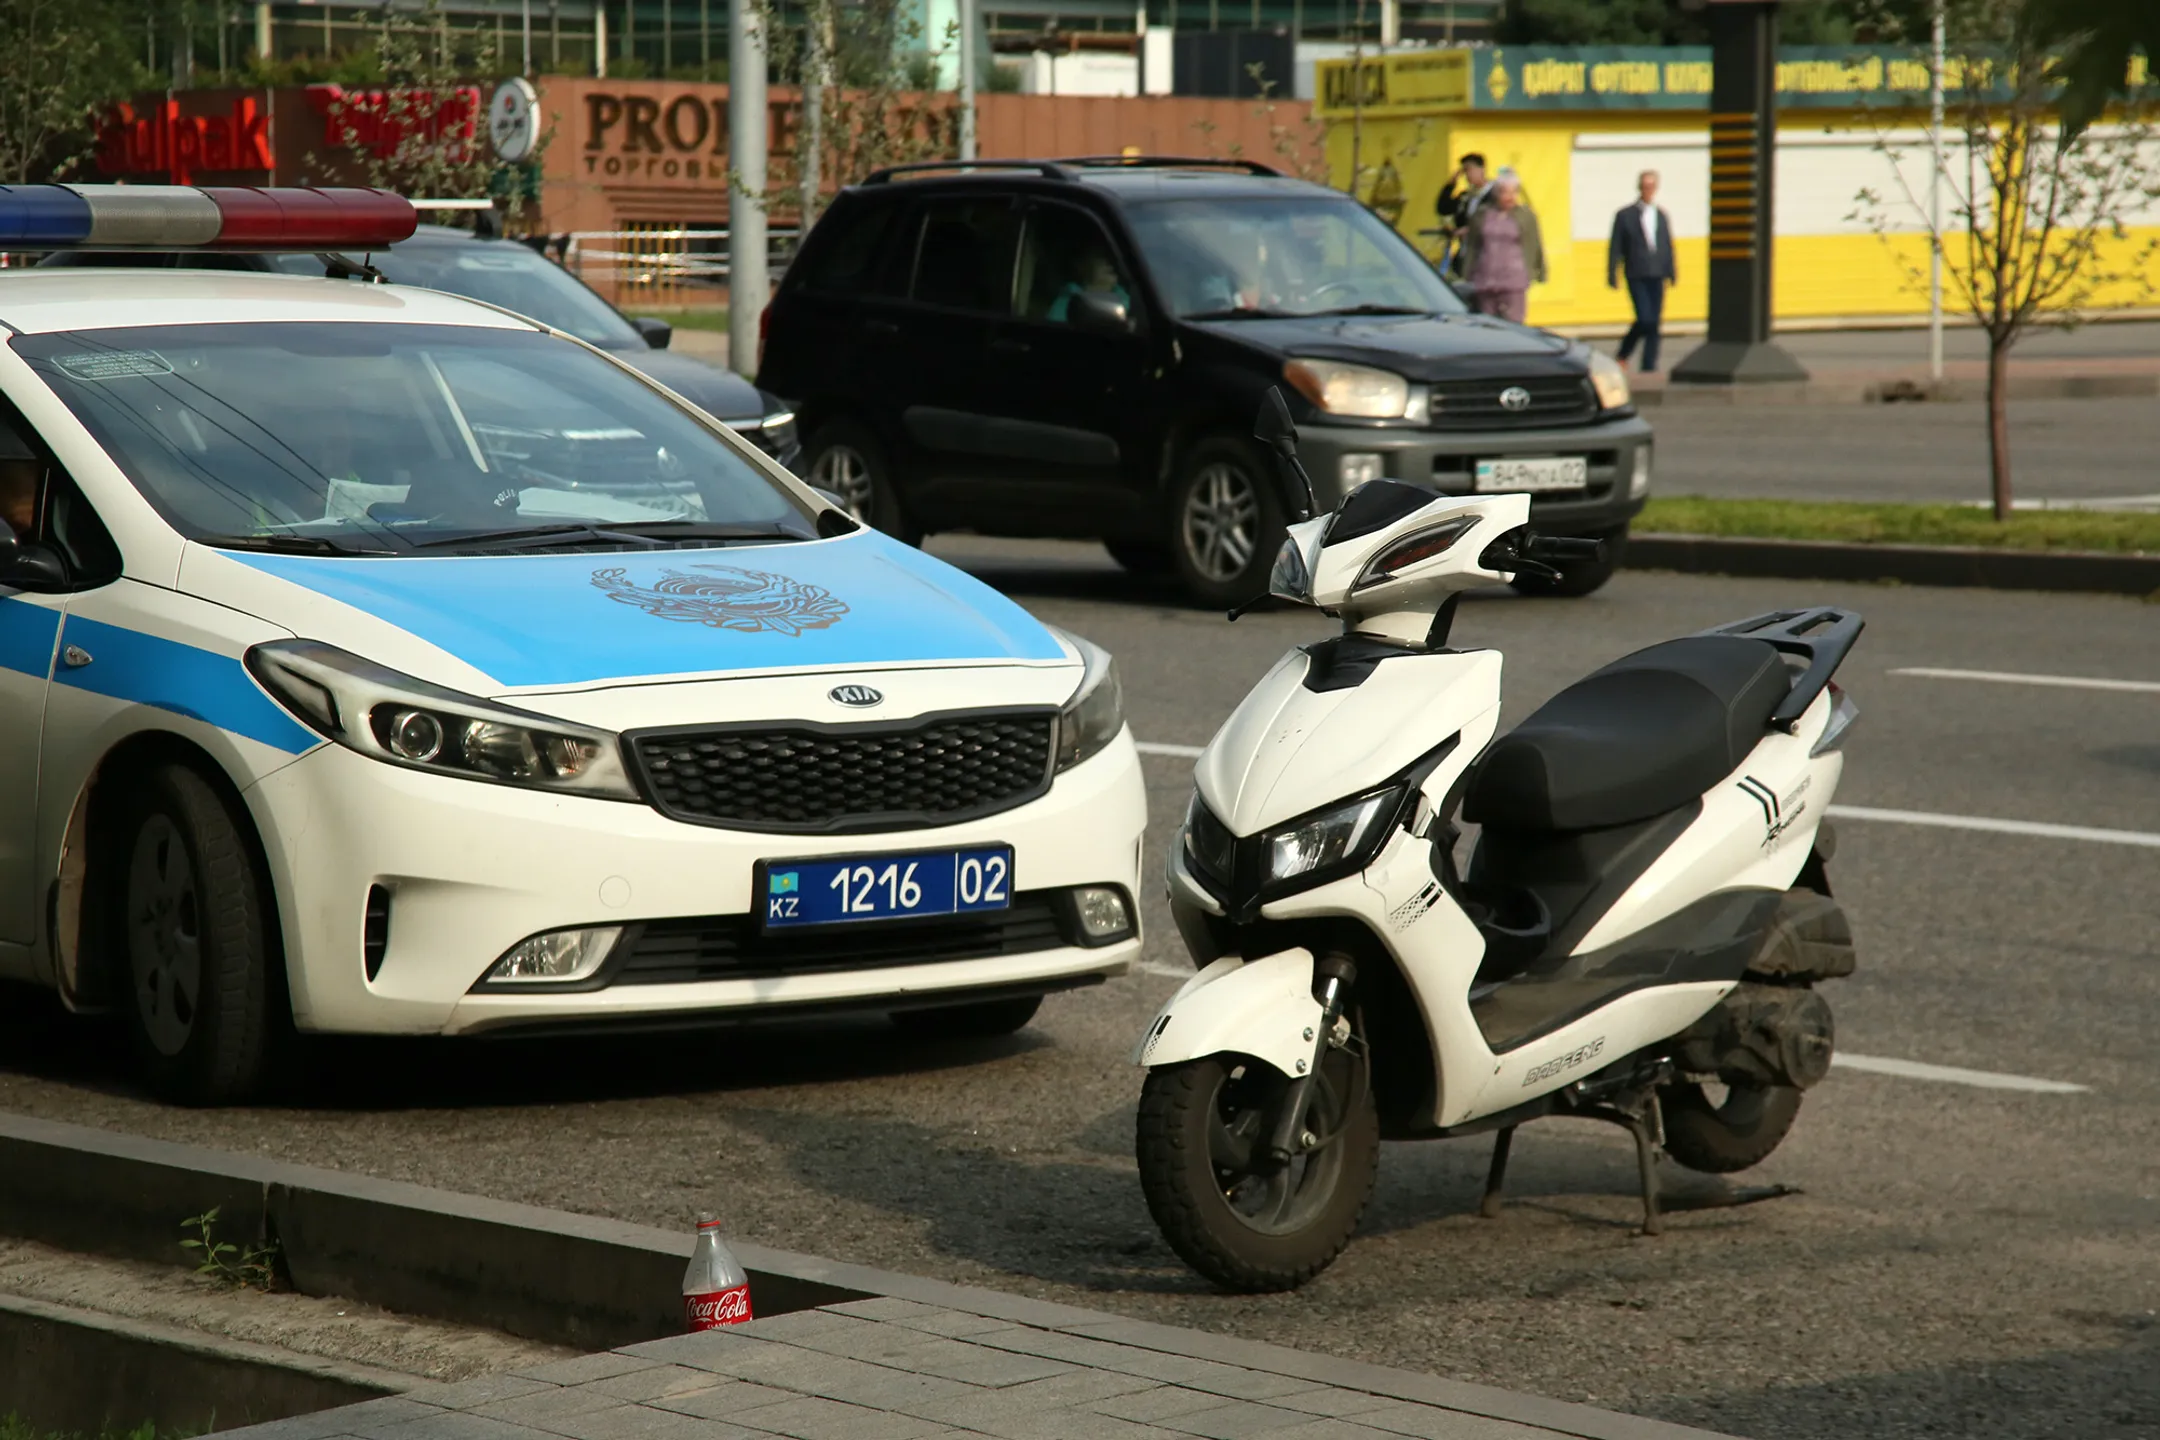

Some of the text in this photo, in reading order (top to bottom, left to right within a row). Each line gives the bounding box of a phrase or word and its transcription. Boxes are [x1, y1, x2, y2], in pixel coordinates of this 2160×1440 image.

[835, 686, 879, 702] KIA
[829, 855, 1007, 914] 1216 02
[769, 897, 800, 919] KZ
[687, 1287, 749, 1321] Coca-Cola
